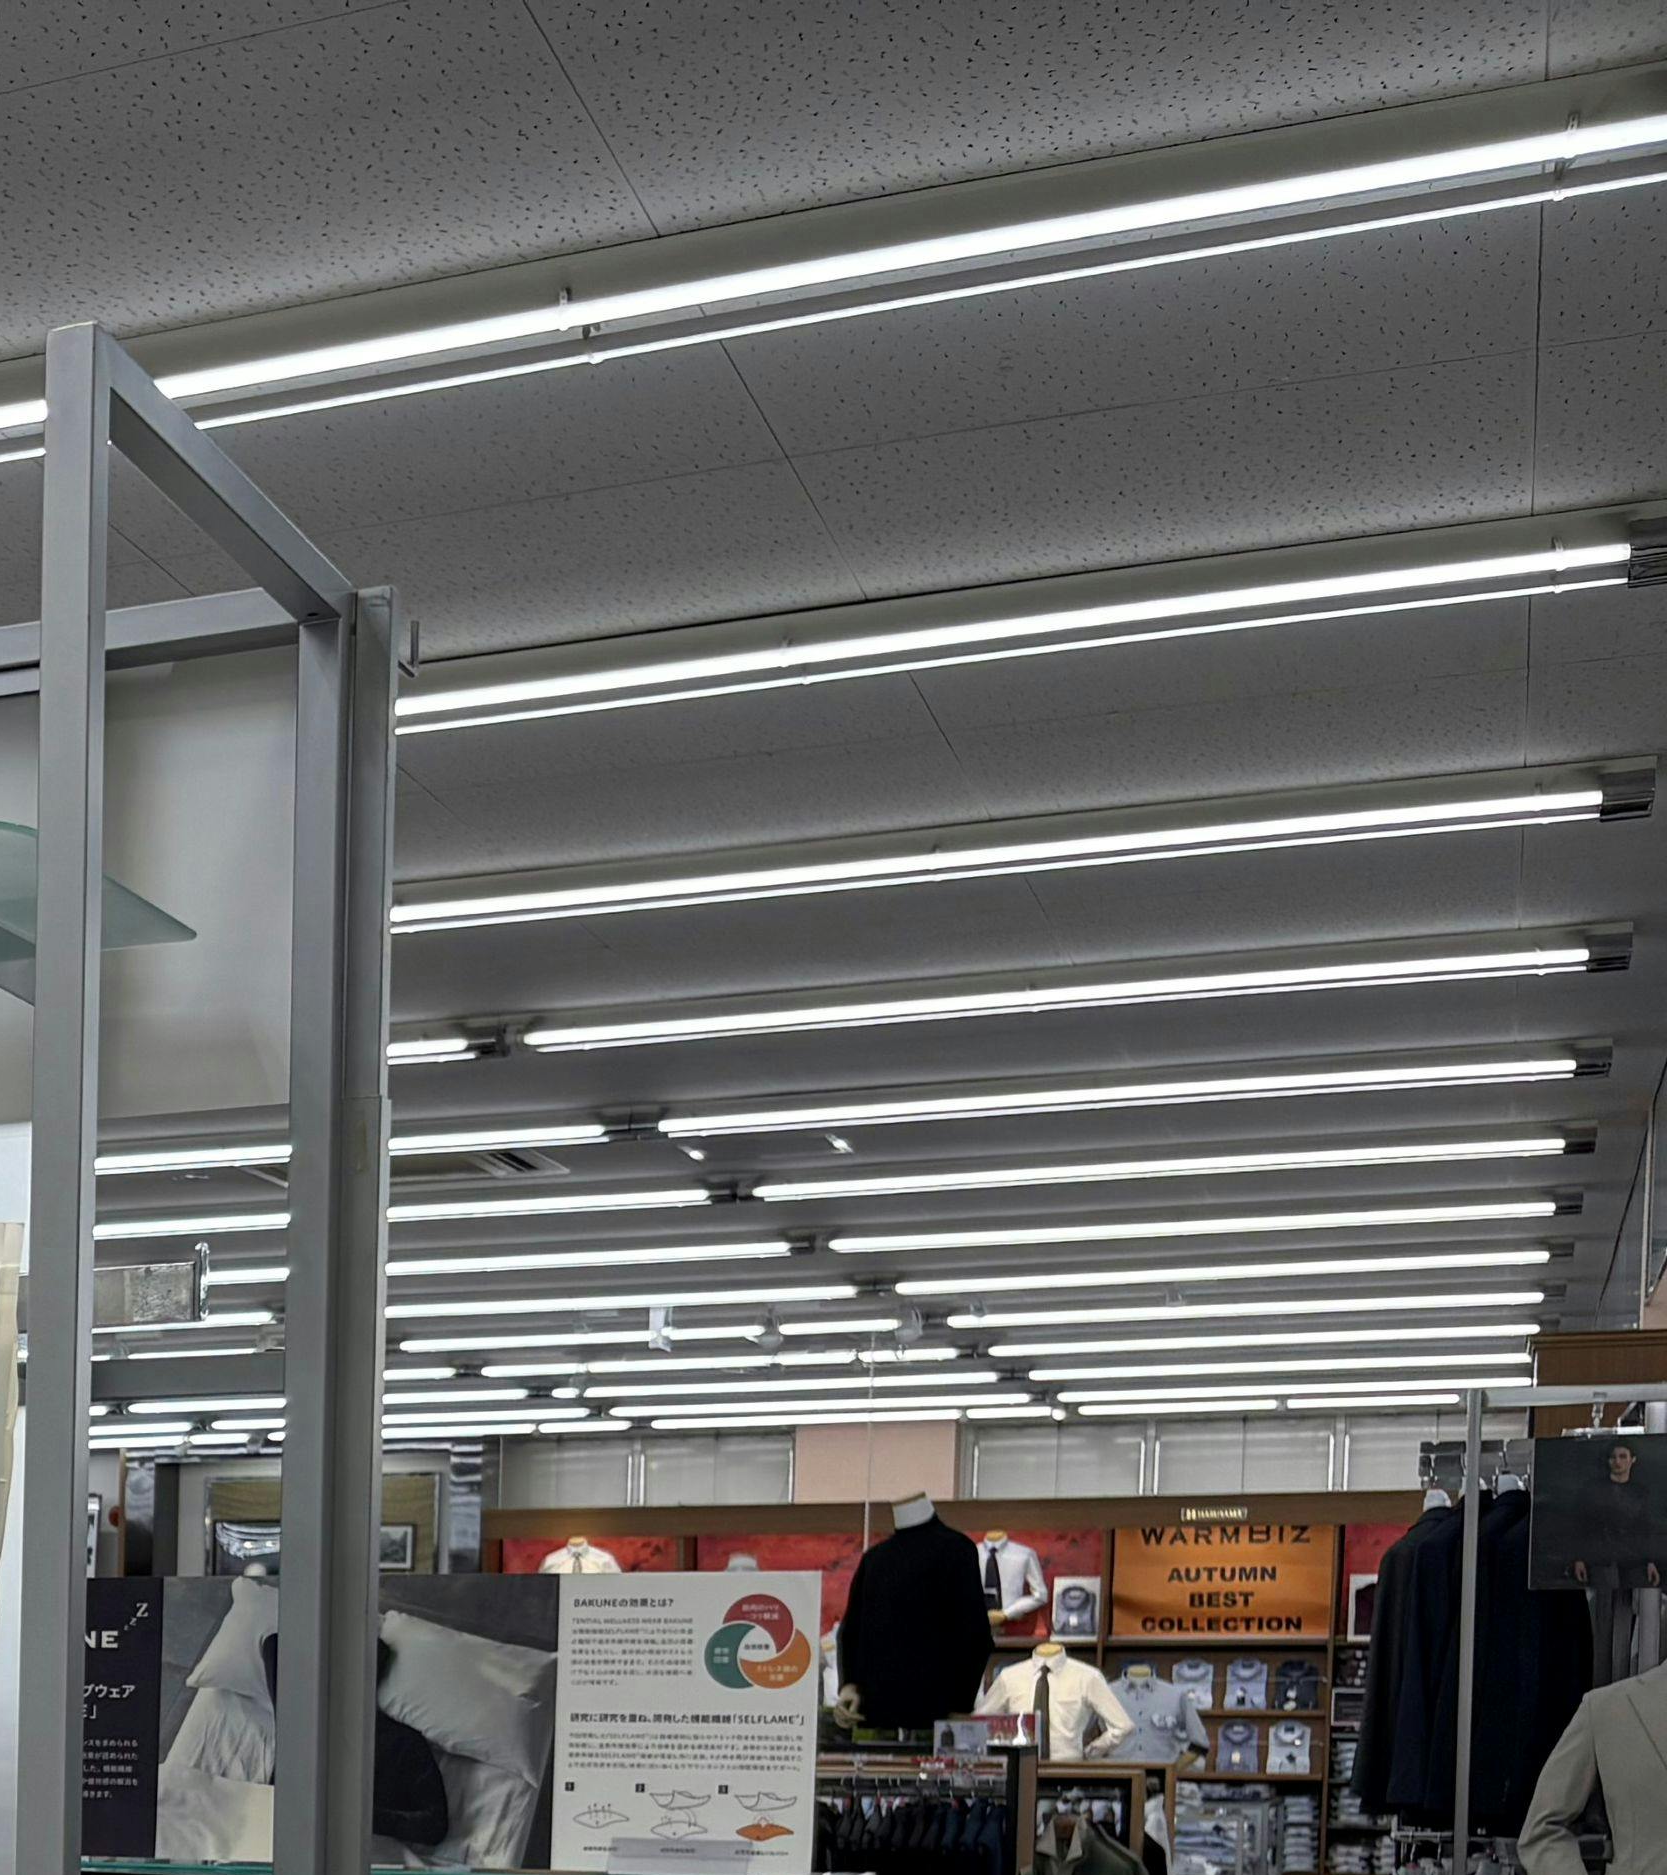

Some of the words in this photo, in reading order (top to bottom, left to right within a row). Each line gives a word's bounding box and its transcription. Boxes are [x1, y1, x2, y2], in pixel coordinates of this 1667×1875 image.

[1141, 1525, 1310, 1546] WARMBIZ
[1168, 1566, 1277, 1583] AUTUMN
[1189, 1592, 1254, 1609] BEST
[1141, 1616, 1302, 1632] COLLECTION
